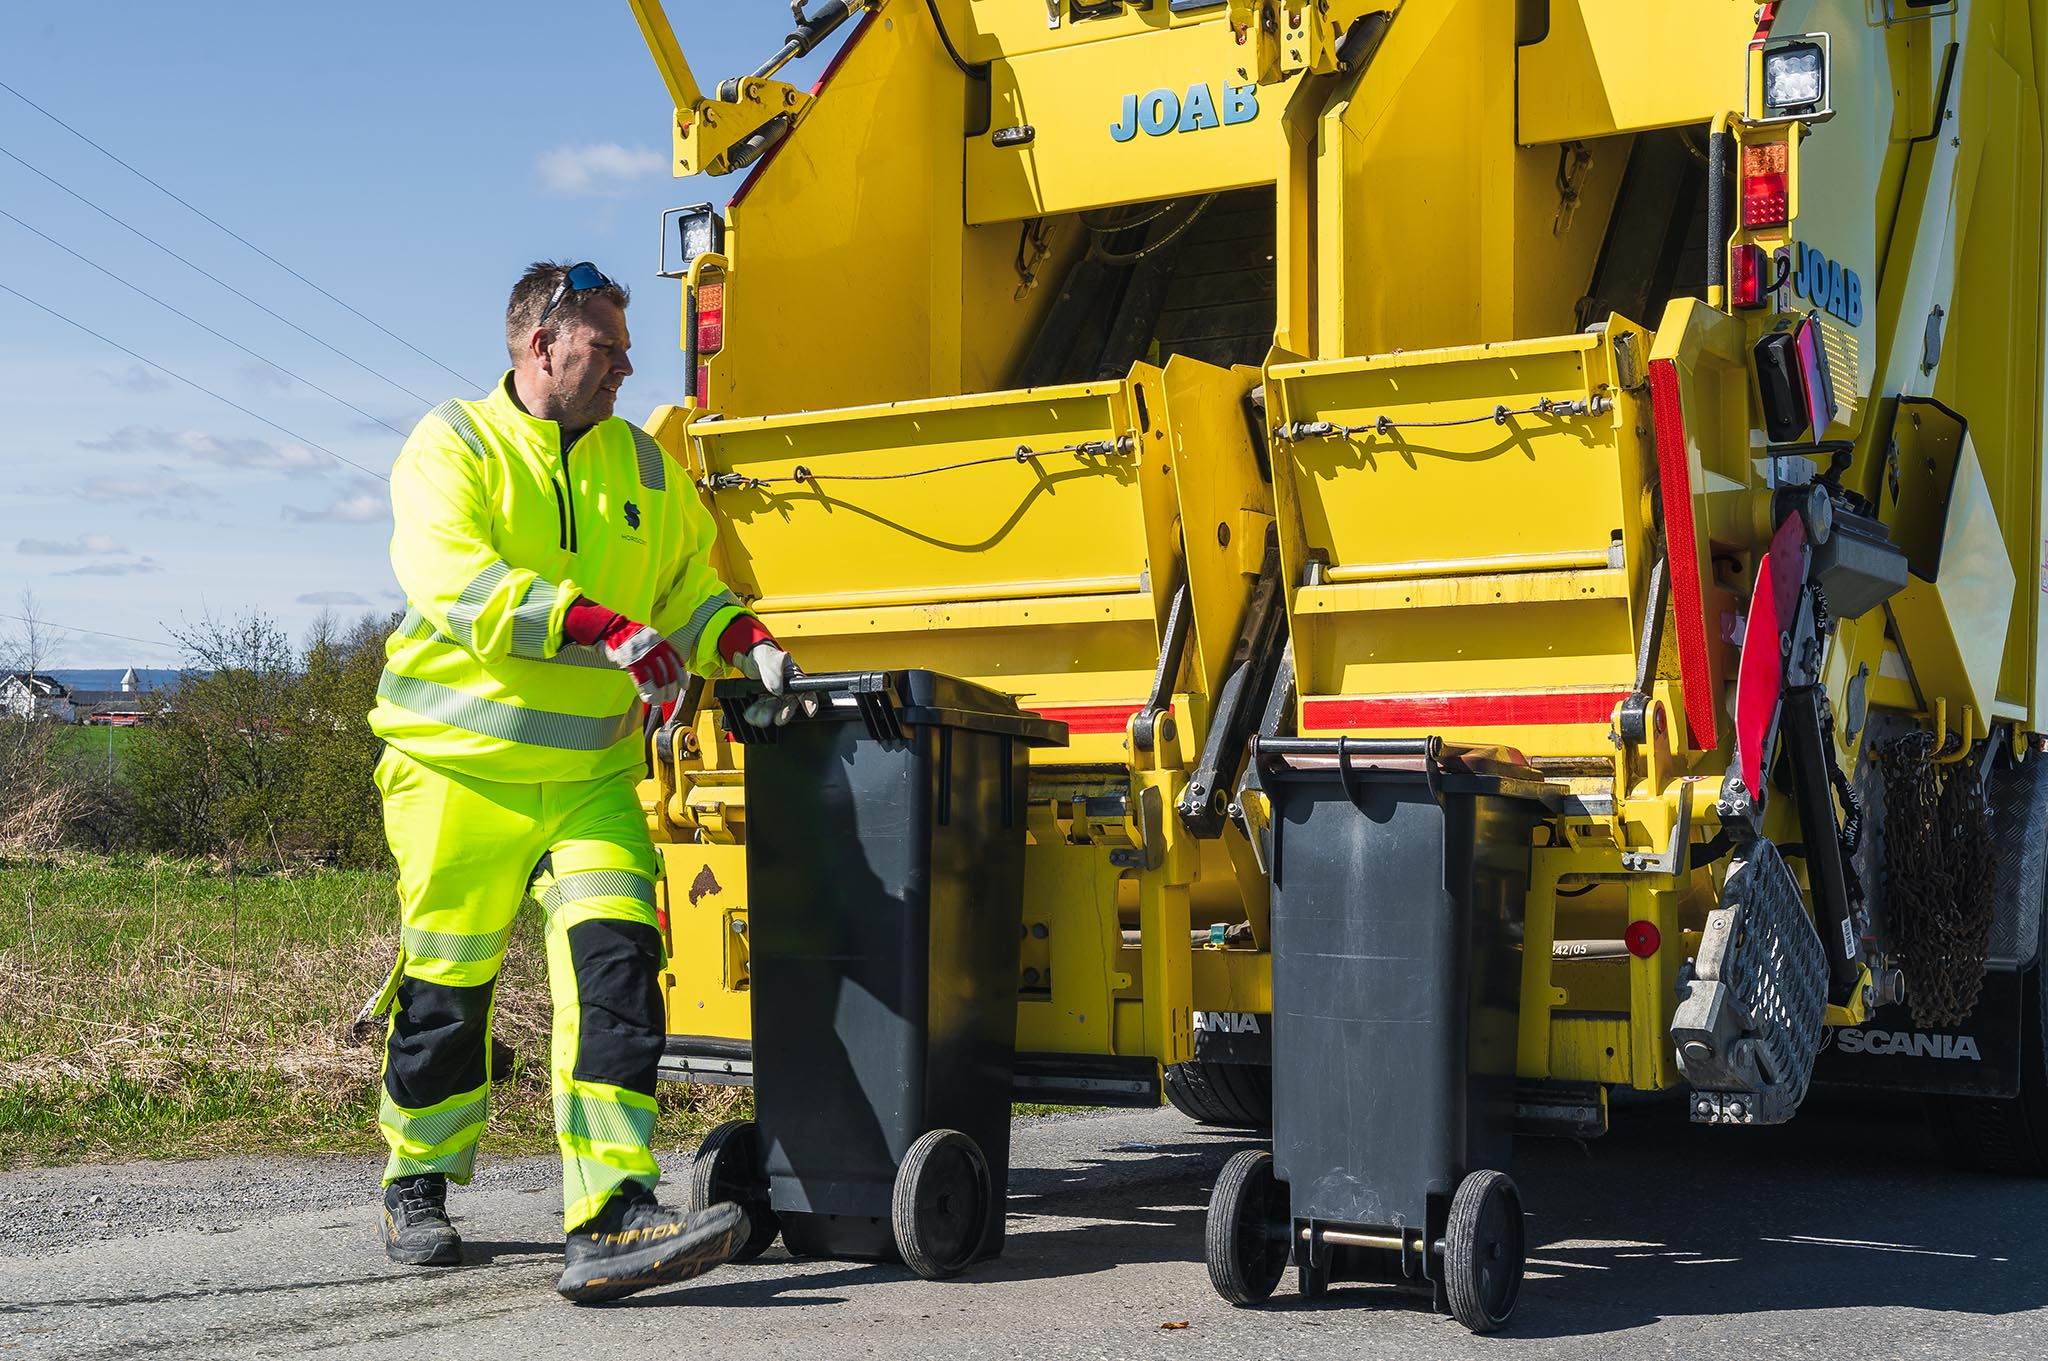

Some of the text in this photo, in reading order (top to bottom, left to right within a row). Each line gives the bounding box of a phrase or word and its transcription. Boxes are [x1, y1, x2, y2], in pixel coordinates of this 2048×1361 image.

[1109, 80, 1260, 142] JOAB
[1795, 241, 1863, 328] JOAB
[1193, 1011, 1261, 1034] ANIA
[1837, 1028, 1981, 1061] SCANIA
